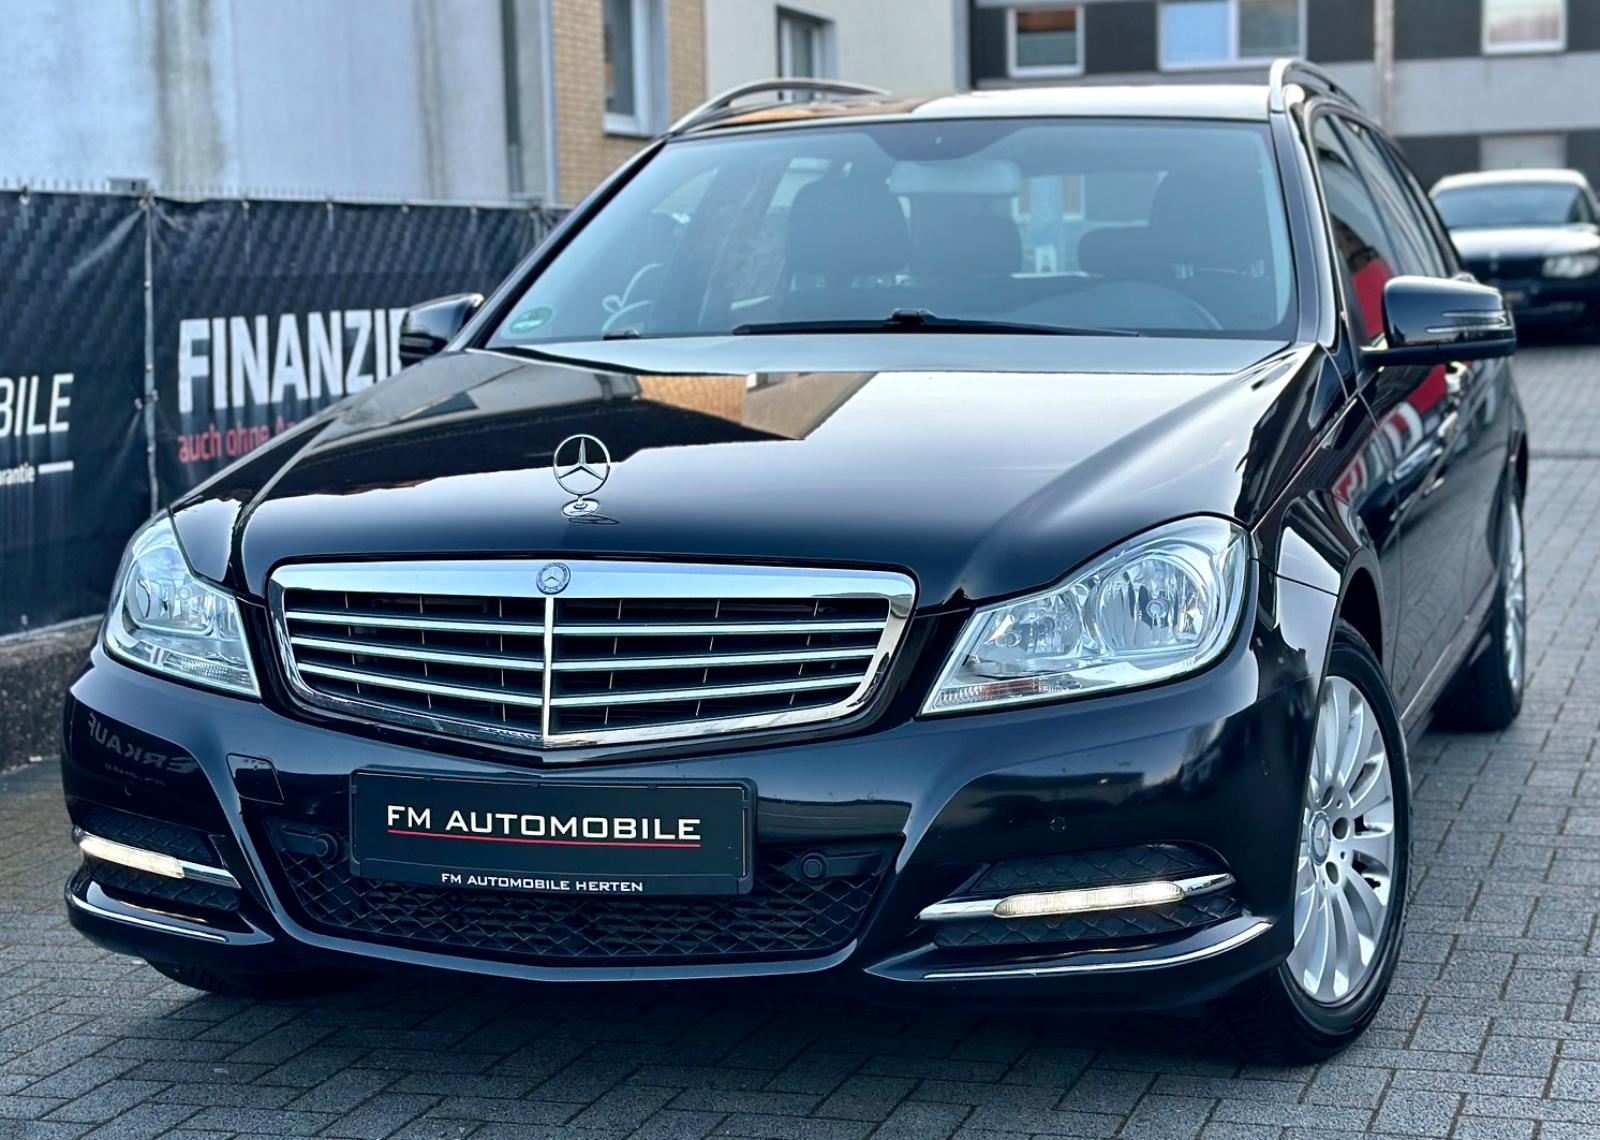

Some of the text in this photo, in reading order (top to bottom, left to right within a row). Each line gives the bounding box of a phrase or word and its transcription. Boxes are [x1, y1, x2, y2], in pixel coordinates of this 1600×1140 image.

[0, 373, 75, 437] BILE
[177, 422, 222, 464] auch
[387, 804, 701, 840] FM AUTOMOBILE
[441, 873, 643, 892] FM AUTOMOBILE HERTEN
